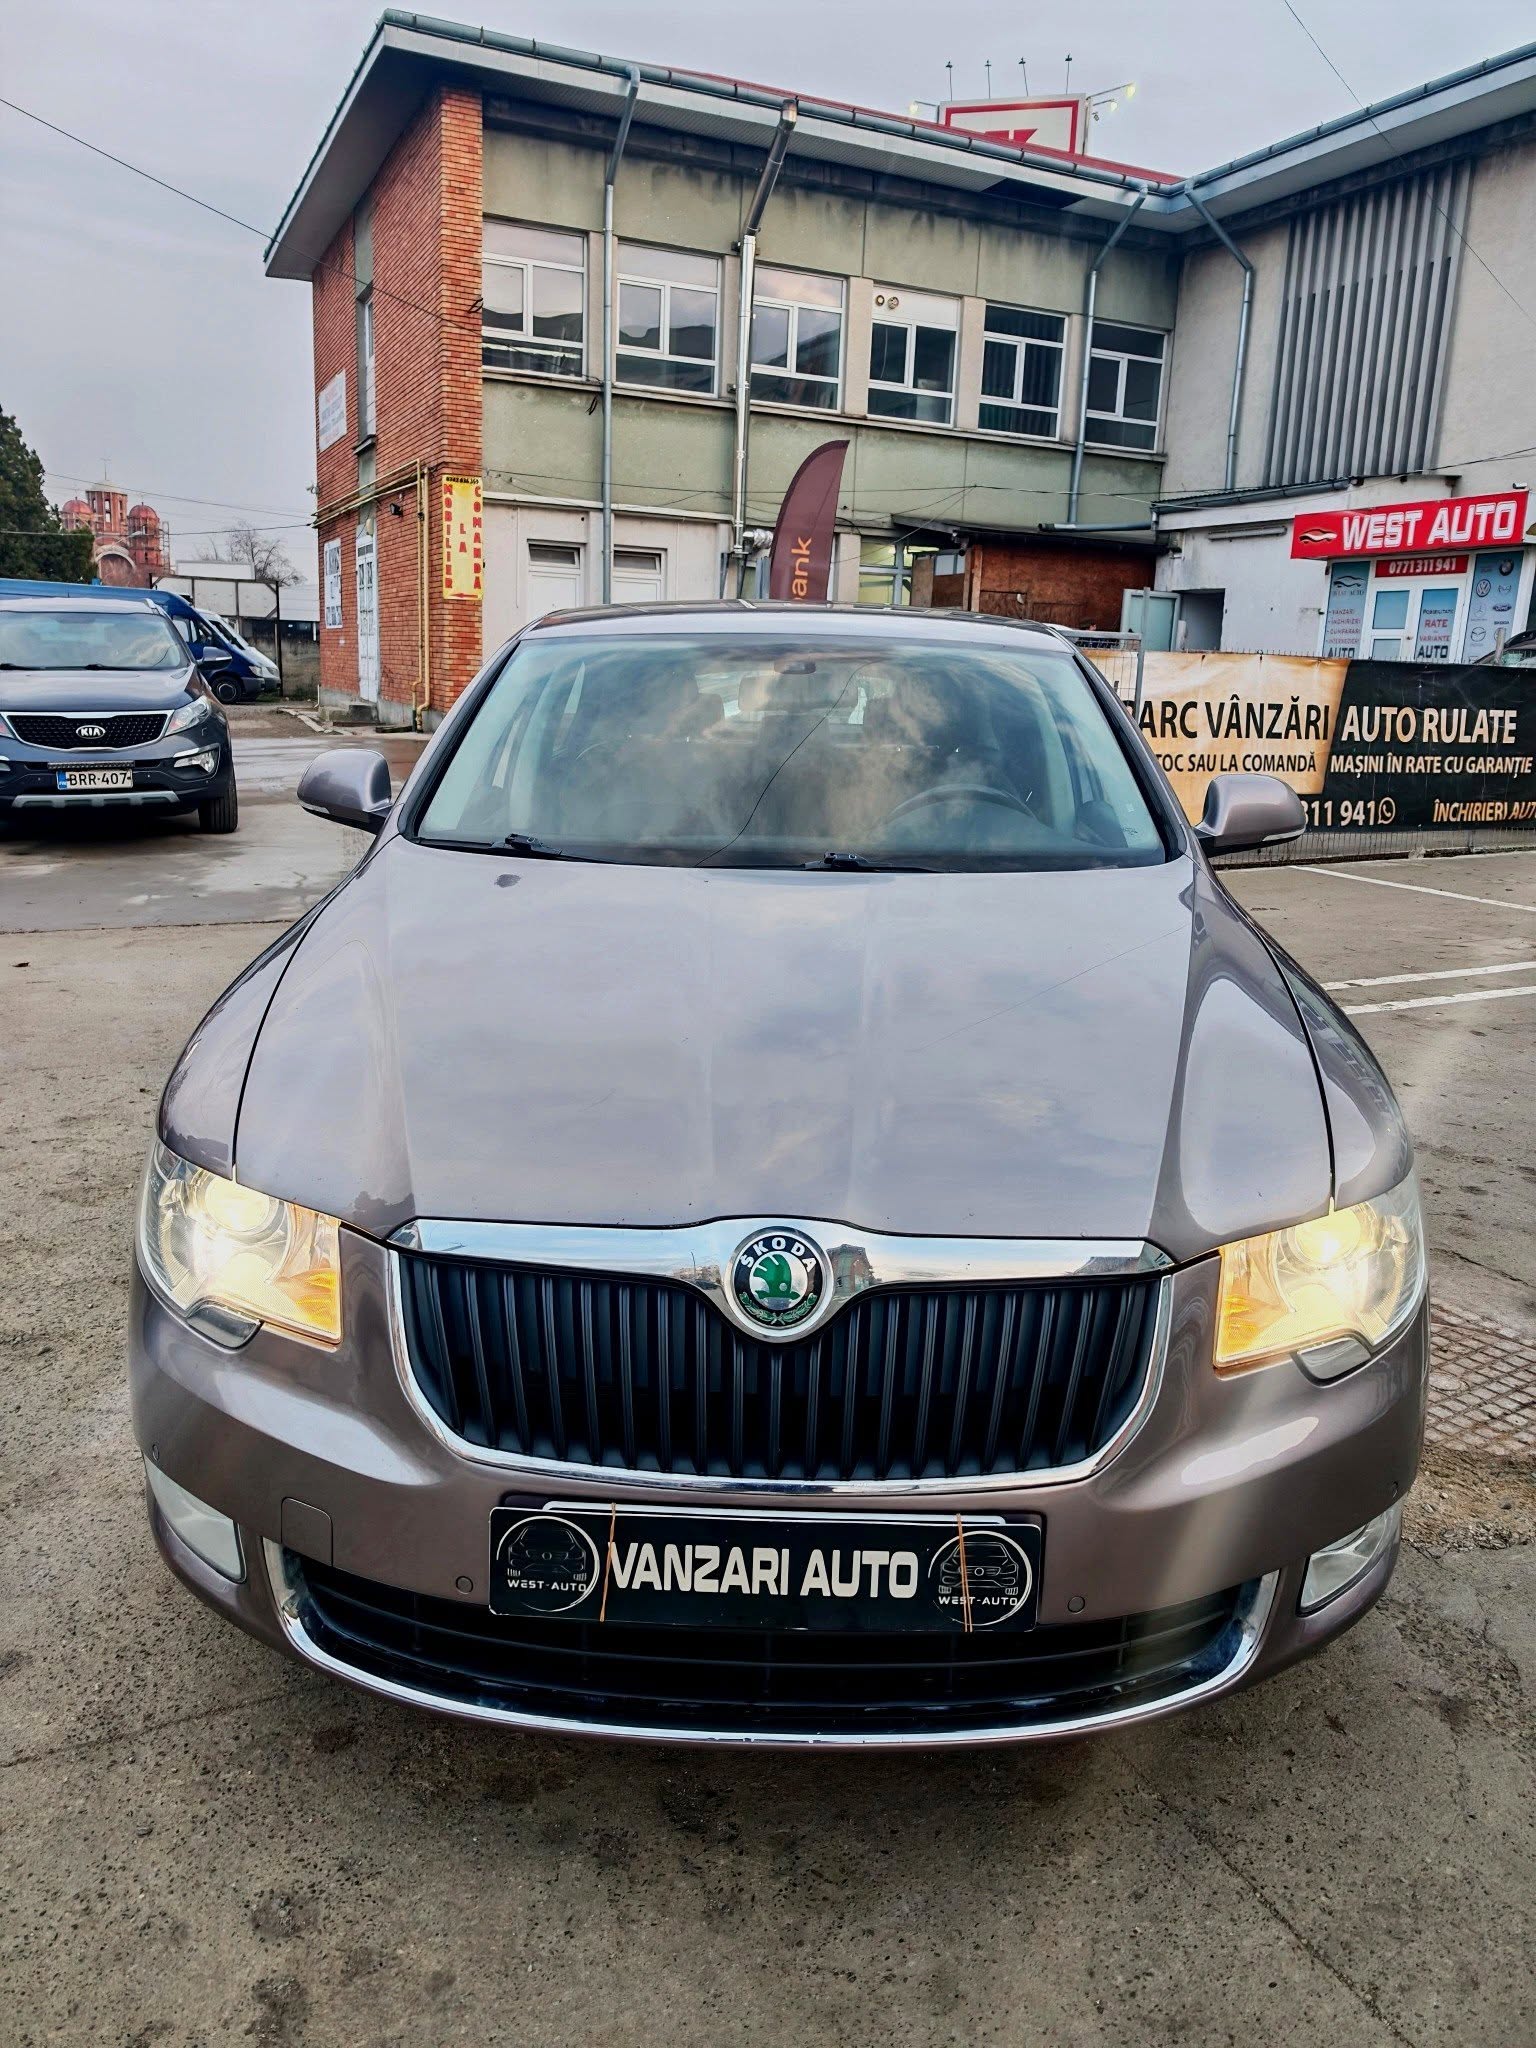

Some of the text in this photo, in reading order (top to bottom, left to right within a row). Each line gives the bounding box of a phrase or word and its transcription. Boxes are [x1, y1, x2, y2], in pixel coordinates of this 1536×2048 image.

[443, 483, 453, 589] MOBILIER
[1342, 500, 1518, 551] WEST AUTO
[459, 523, 467, 553] LA
[472, 485, 482, 590] COMANDA
[791, 536, 812, 600] ank
[1388, 557, 1457, 575] 0771311941
[1424, 619, 1448, 629] RATE
[1328, 647, 1355, 659] AUTO
[1417, 645, 1449, 659] AUTO
[1205, 693, 1330, 740] VÂNZĂRI
[1341, 705, 1417, 744] AUTO
[1422, 707, 1518, 744] RULATE
[81, 727, 101, 737] KIA
[1187, 753, 1217, 772] SAU
[1220, 754, 1239, 772] LA
[1242, 751, 1317, 772] COMANDĂ
[1387, 752, 1403, 773] ÎN
[1405, 756, 1442, 773] RATE
[1444, 756, 1463, 774] CU
[68, 772, 127, 786] BRR-407
[1339, 800, 1376, 827] 941
[1432, 798, 1508, 823] ÎNCHIRIERI
[607, 1541, 919, 1599] VANZARI AUTO
[507, 1579, 587, 1592] WEST-AUTO
[938, 1595, 1018, 1606] WEST-AUTO
